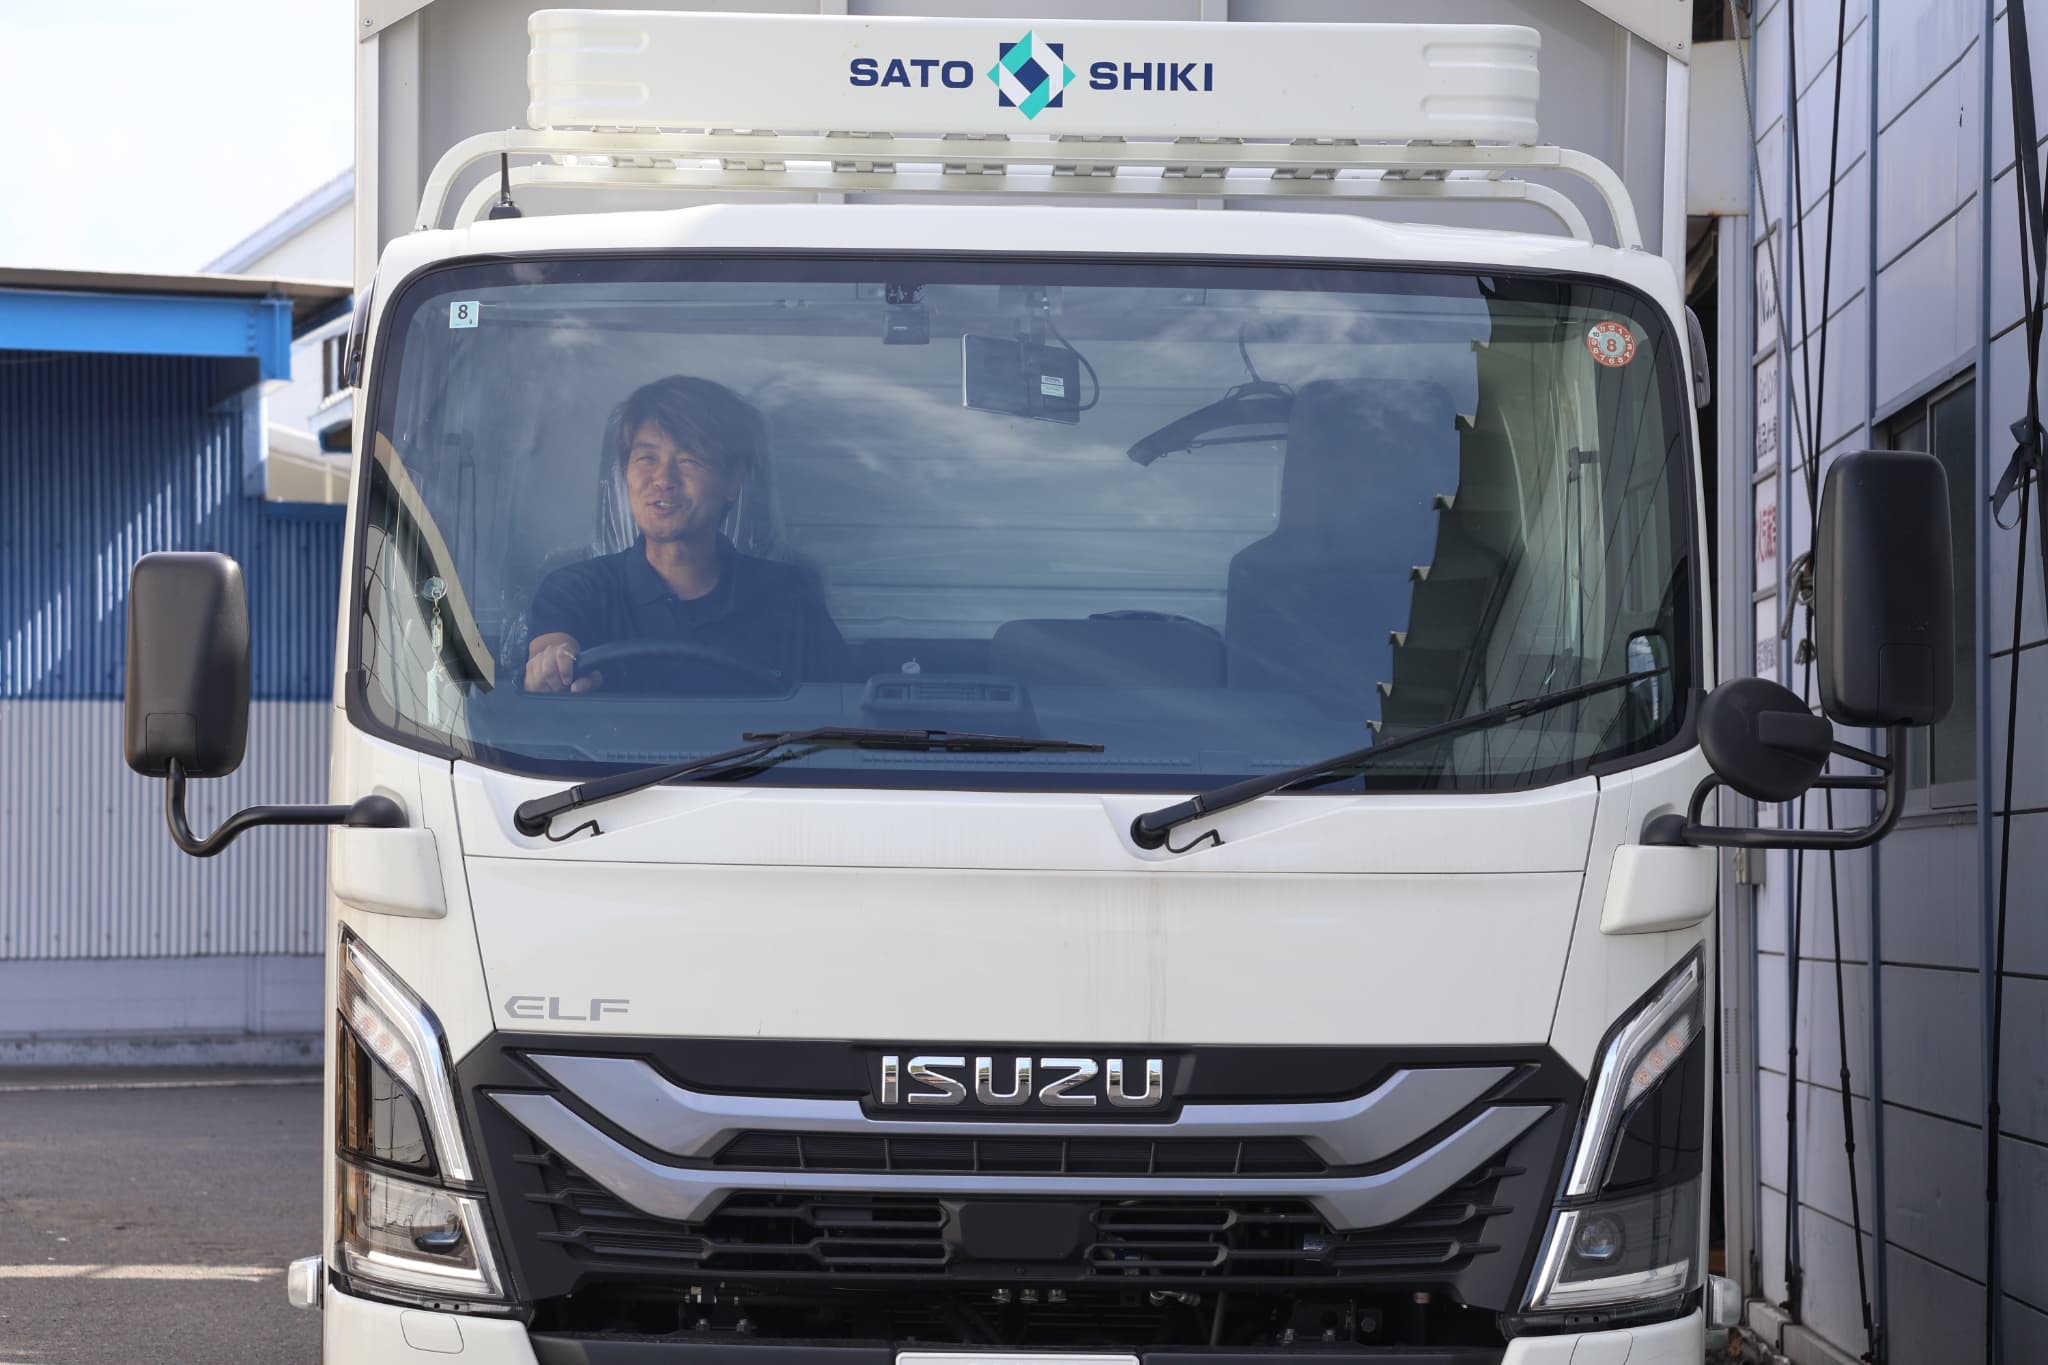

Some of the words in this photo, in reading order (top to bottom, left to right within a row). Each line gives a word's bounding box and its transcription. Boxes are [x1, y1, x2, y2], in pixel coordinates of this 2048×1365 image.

[850, 58, 974, 89] SATO
[1089, 61, 1213, 92] SHIKI
[458, 304, 468, 319] 8
[1607, 338, 1617, 352] 8
[504, 996, 630, 1021] ELF
[881, 1055, 1163, 1107] ISUZU
